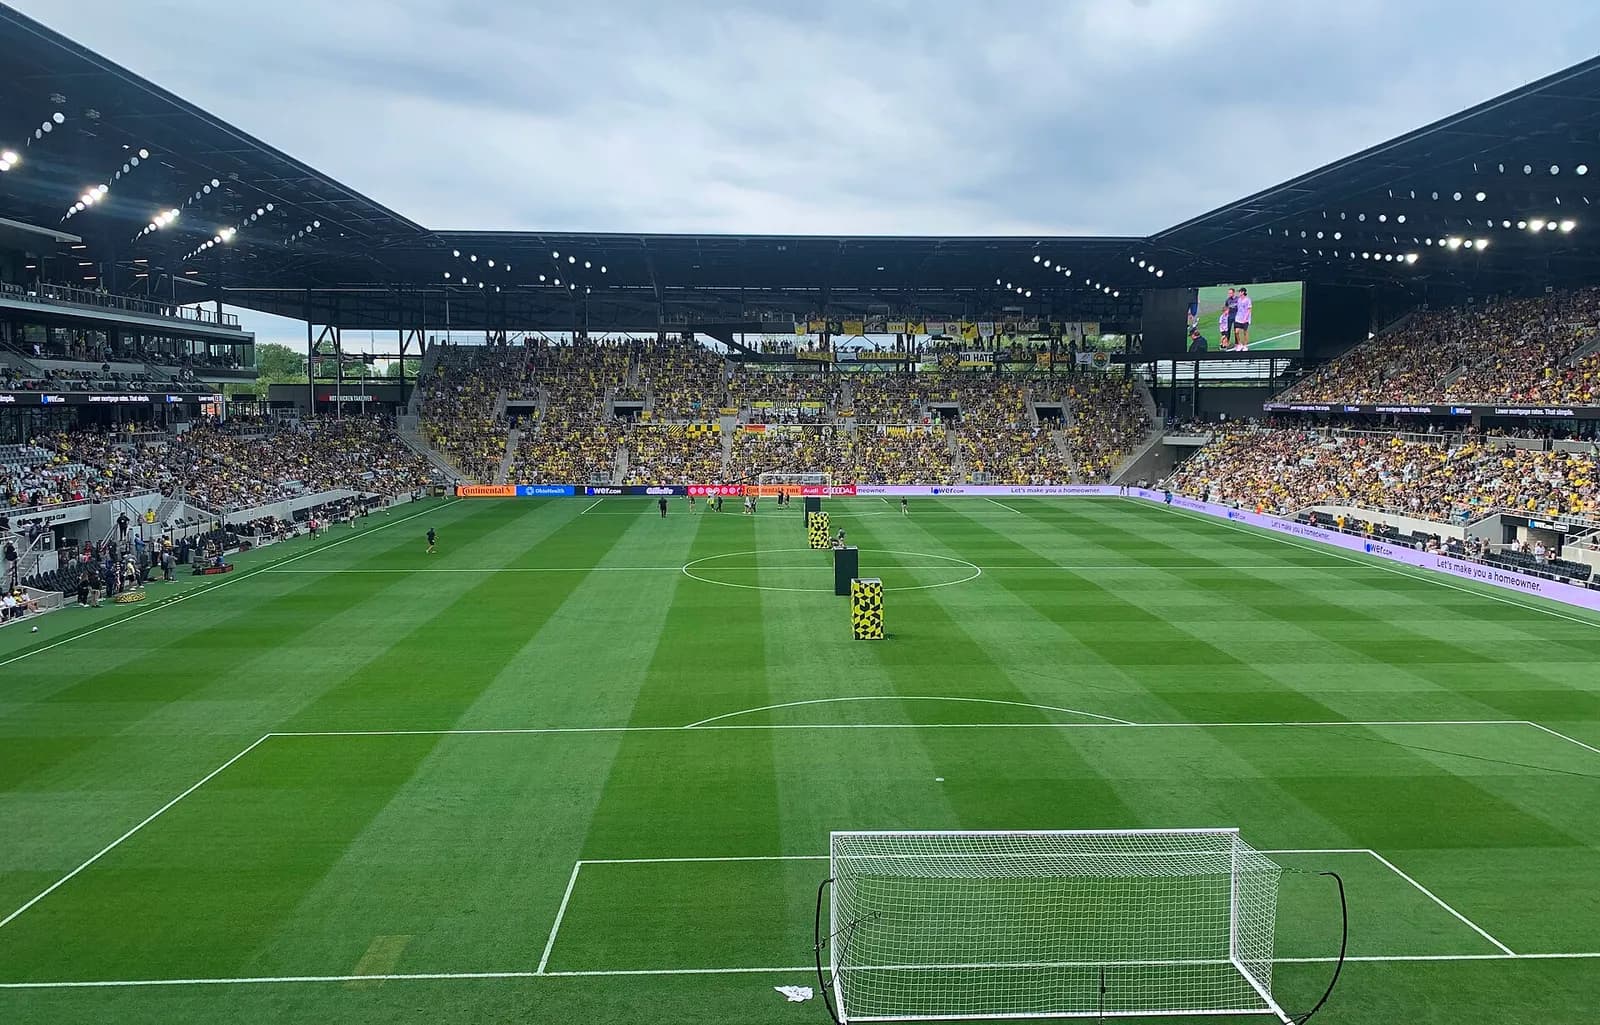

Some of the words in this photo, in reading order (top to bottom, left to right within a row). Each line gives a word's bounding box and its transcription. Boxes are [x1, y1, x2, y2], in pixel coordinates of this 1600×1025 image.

[960, 353, 970, 361] NO
[973, 353, 993, 362] HATE
[1509, 408, 1530, 416] mortgage
[463, 487, 504, 496] Continental
[584, 486, 621, 496] lower.com
[646, 487, 674, 495] Gillette
[746, 487, 777, 495] Contnental
[1364, 539, 1393, 555] lower.com
[1436, 559, 1452, 570] Let's
[1454, 564, 1472, 575] make
[1473, 568, 1486, 578] you
[1488, 572, 1493, 580] a
[1494, 571, 1542, 592] homeowner.
